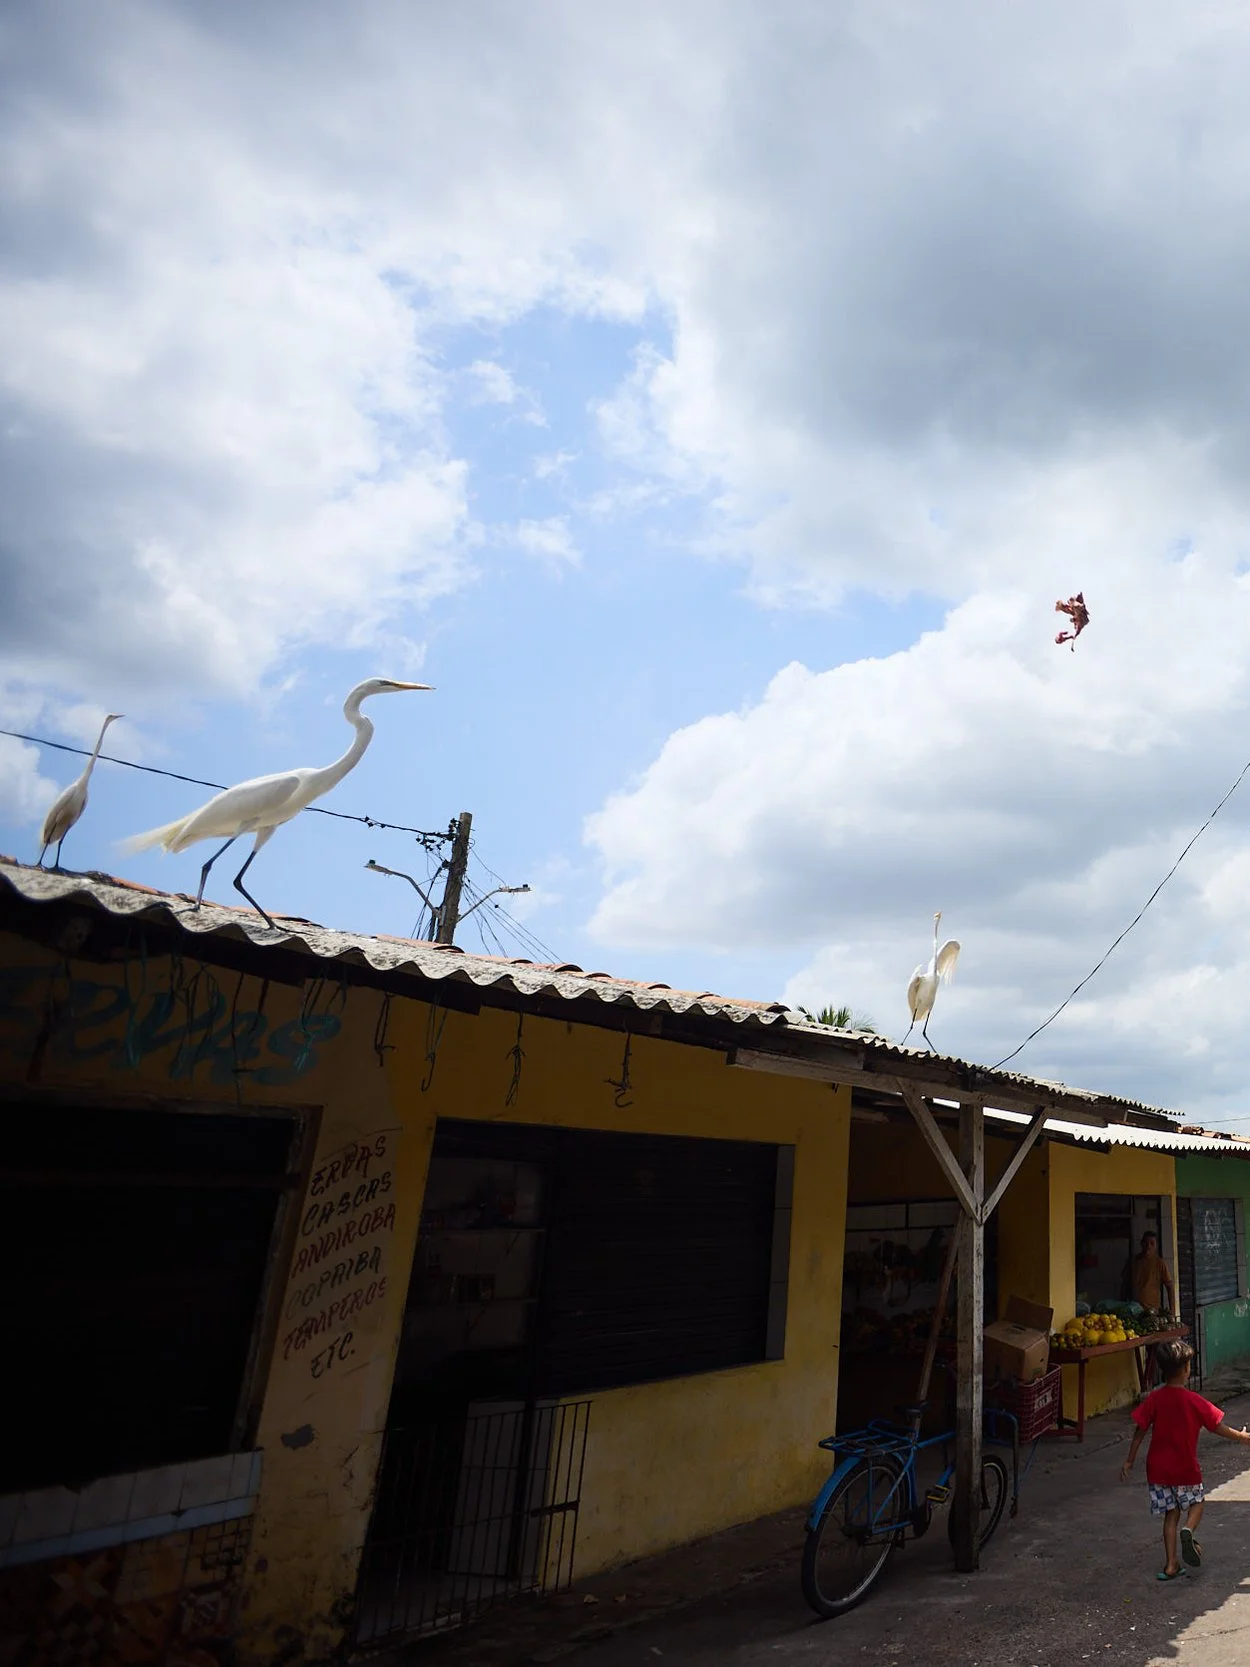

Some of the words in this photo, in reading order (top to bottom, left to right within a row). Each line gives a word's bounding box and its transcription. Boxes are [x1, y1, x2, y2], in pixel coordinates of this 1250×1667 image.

[302, 1171, 392, 1237] CASCAS
[290, 1203, 397, 1279] ANDIROBA
[310, 1332, 356, 1379] ETC.
